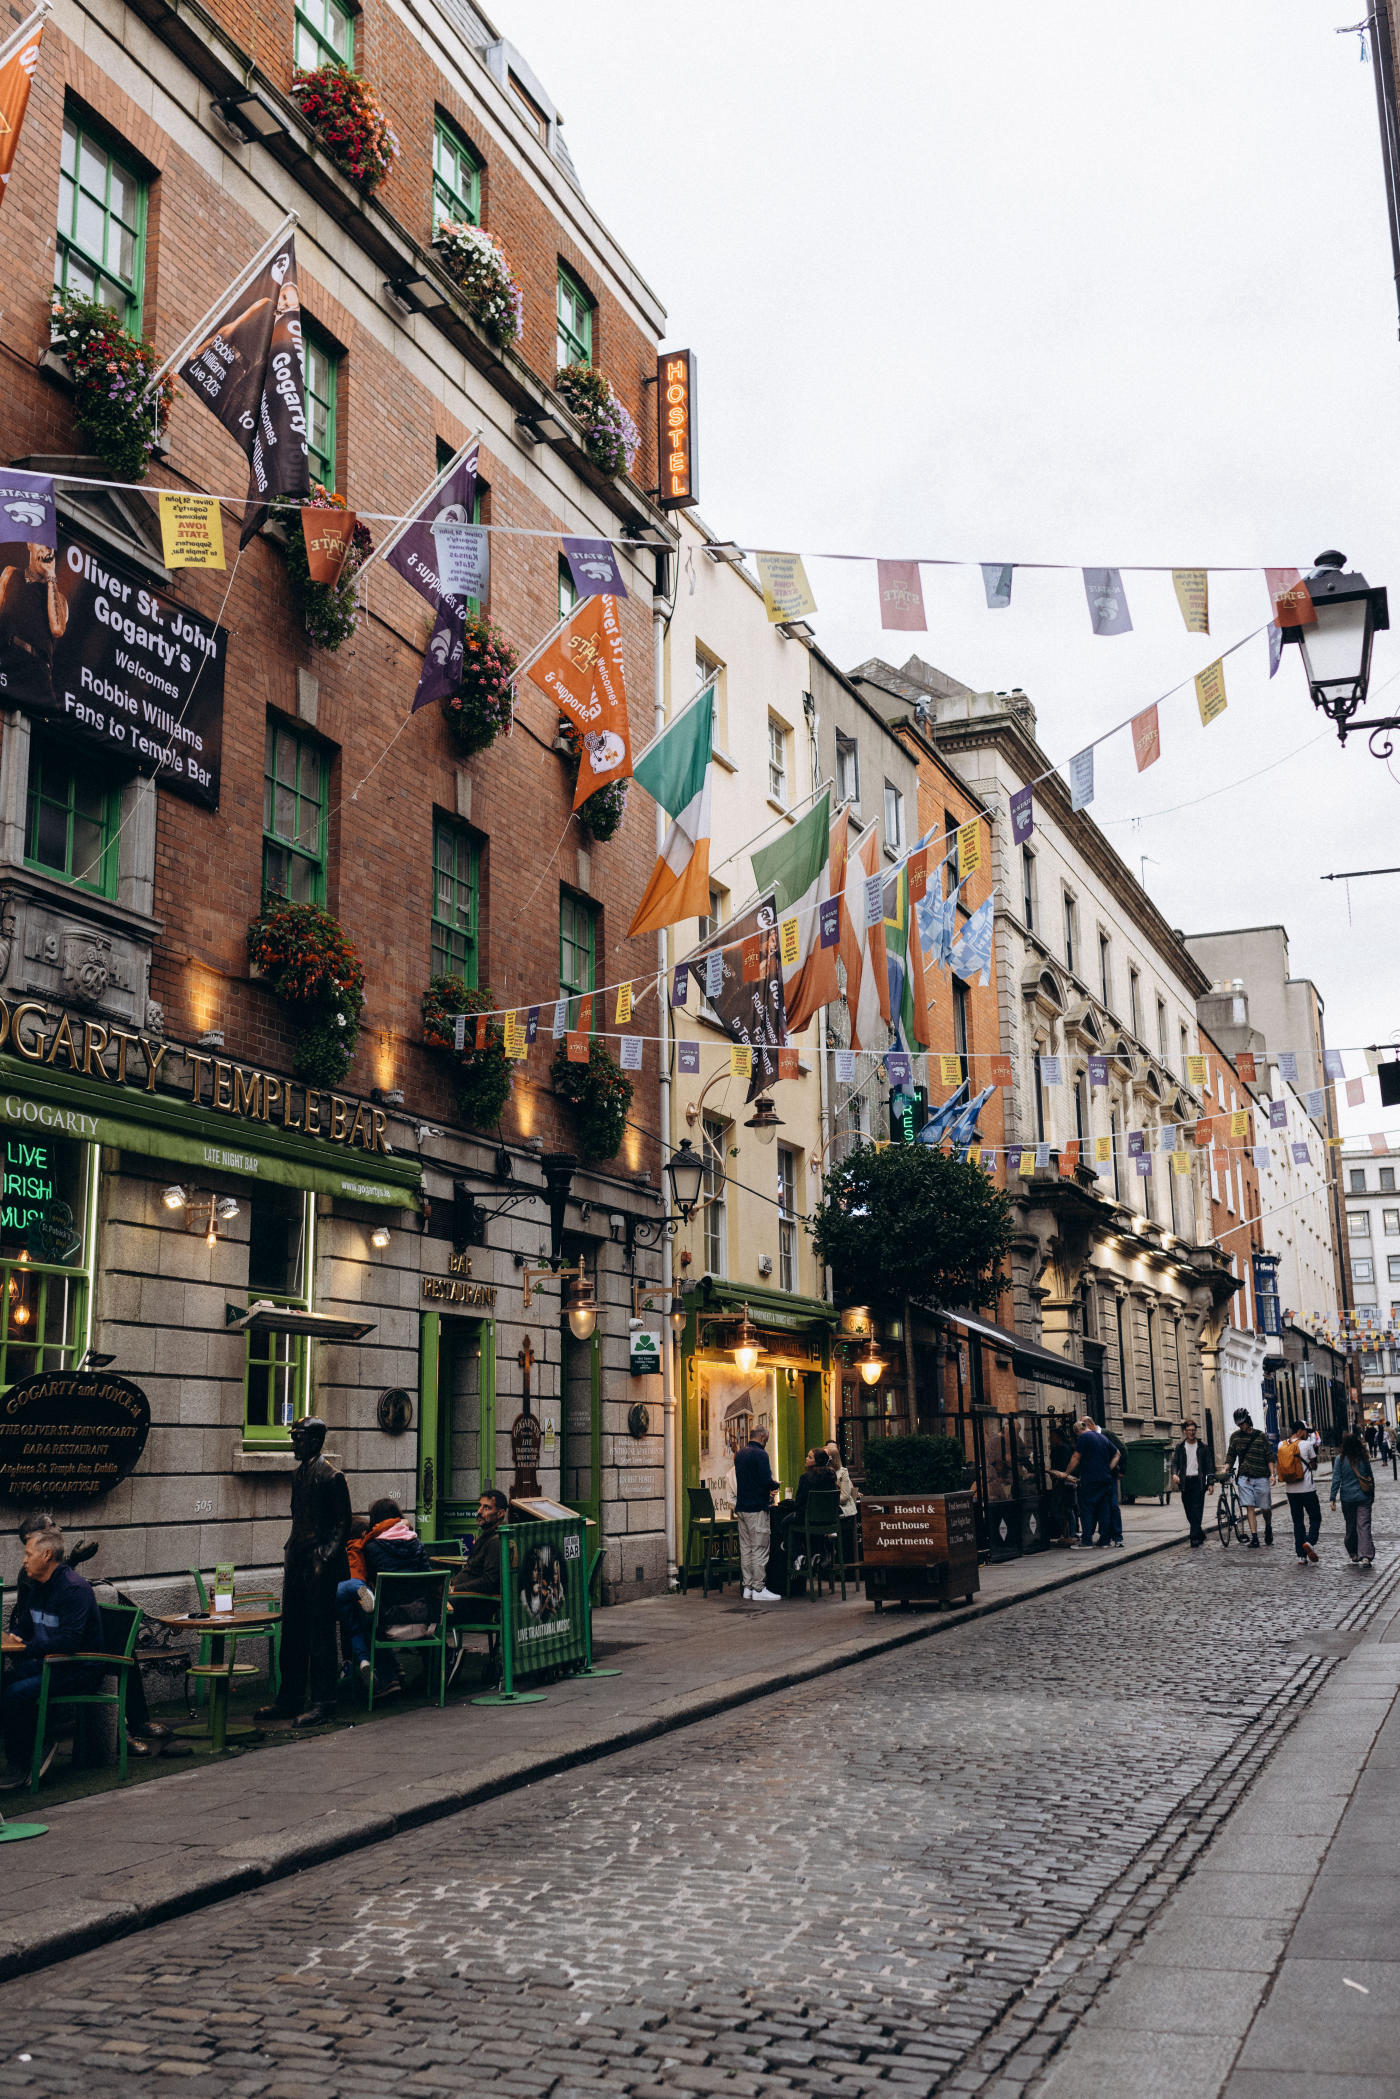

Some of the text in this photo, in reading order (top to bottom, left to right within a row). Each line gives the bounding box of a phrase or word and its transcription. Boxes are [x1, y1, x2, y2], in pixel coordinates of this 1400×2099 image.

[189, 361, 205, 382] Live
[201, 348, 227, 381] Williams
[239, 410, 254, 429] to
[667, 360, 686, 494] HOSTEL
[407, 552, 418, 565] &
[455, 604, 467, 620] to
[67, 545, 217, 659] Oliver St. John
[94, 597, 191, 672] Gogarty's
[115, 650, 179, 699] Welcomes
[597, 656, 619, 706] Welcomes
[81, 667, 203, 751] Robbie Williams
[545, 671, 590, 723] & supporte
[65, 692, 212, 788] Fans to Temple Bar
[0, 1001, 391, 1154] GARTY TEMPLE BAR
[6, 1096, 100, 1135] GOGARTY
[7, 1141, 47, 1170] LIVE
[204, 1147, 259, 1172] LATE NIGHT BAR
[2, 1173, 53, 1200] IRISH
[449, 1253, 473, 1275] BAR
[423, 1277, 498, 1307] RESTAURANT
[6, 1381, 78, 1415] GOGARTY
[78, 1384, 98, 1397] and
[99, 1384, 134, 1409] JOYCE
[0, 1424, 20, 1435] THE
[21, 1424, 57, 1436] OLIVER
[71, 1425, 96, 1436] JOHN
[96, 1426, 139, 1437] GOGARTY
[23, 1443, 42, 1455] BAR
[51, 1444, 110, 1455] RESTAURANT
[194, 1500, 213, 1512] 505
[894, 1504, 935, 1514] Hostel &
[880, 1521, 930, 1530] Penthouse
[566, 1545, 579, 1558] BAR
[876, 1537, 934, 1548] Apartments
[517, 1618, 570, 1642] LIVE TRADITIONAL MUSIC
